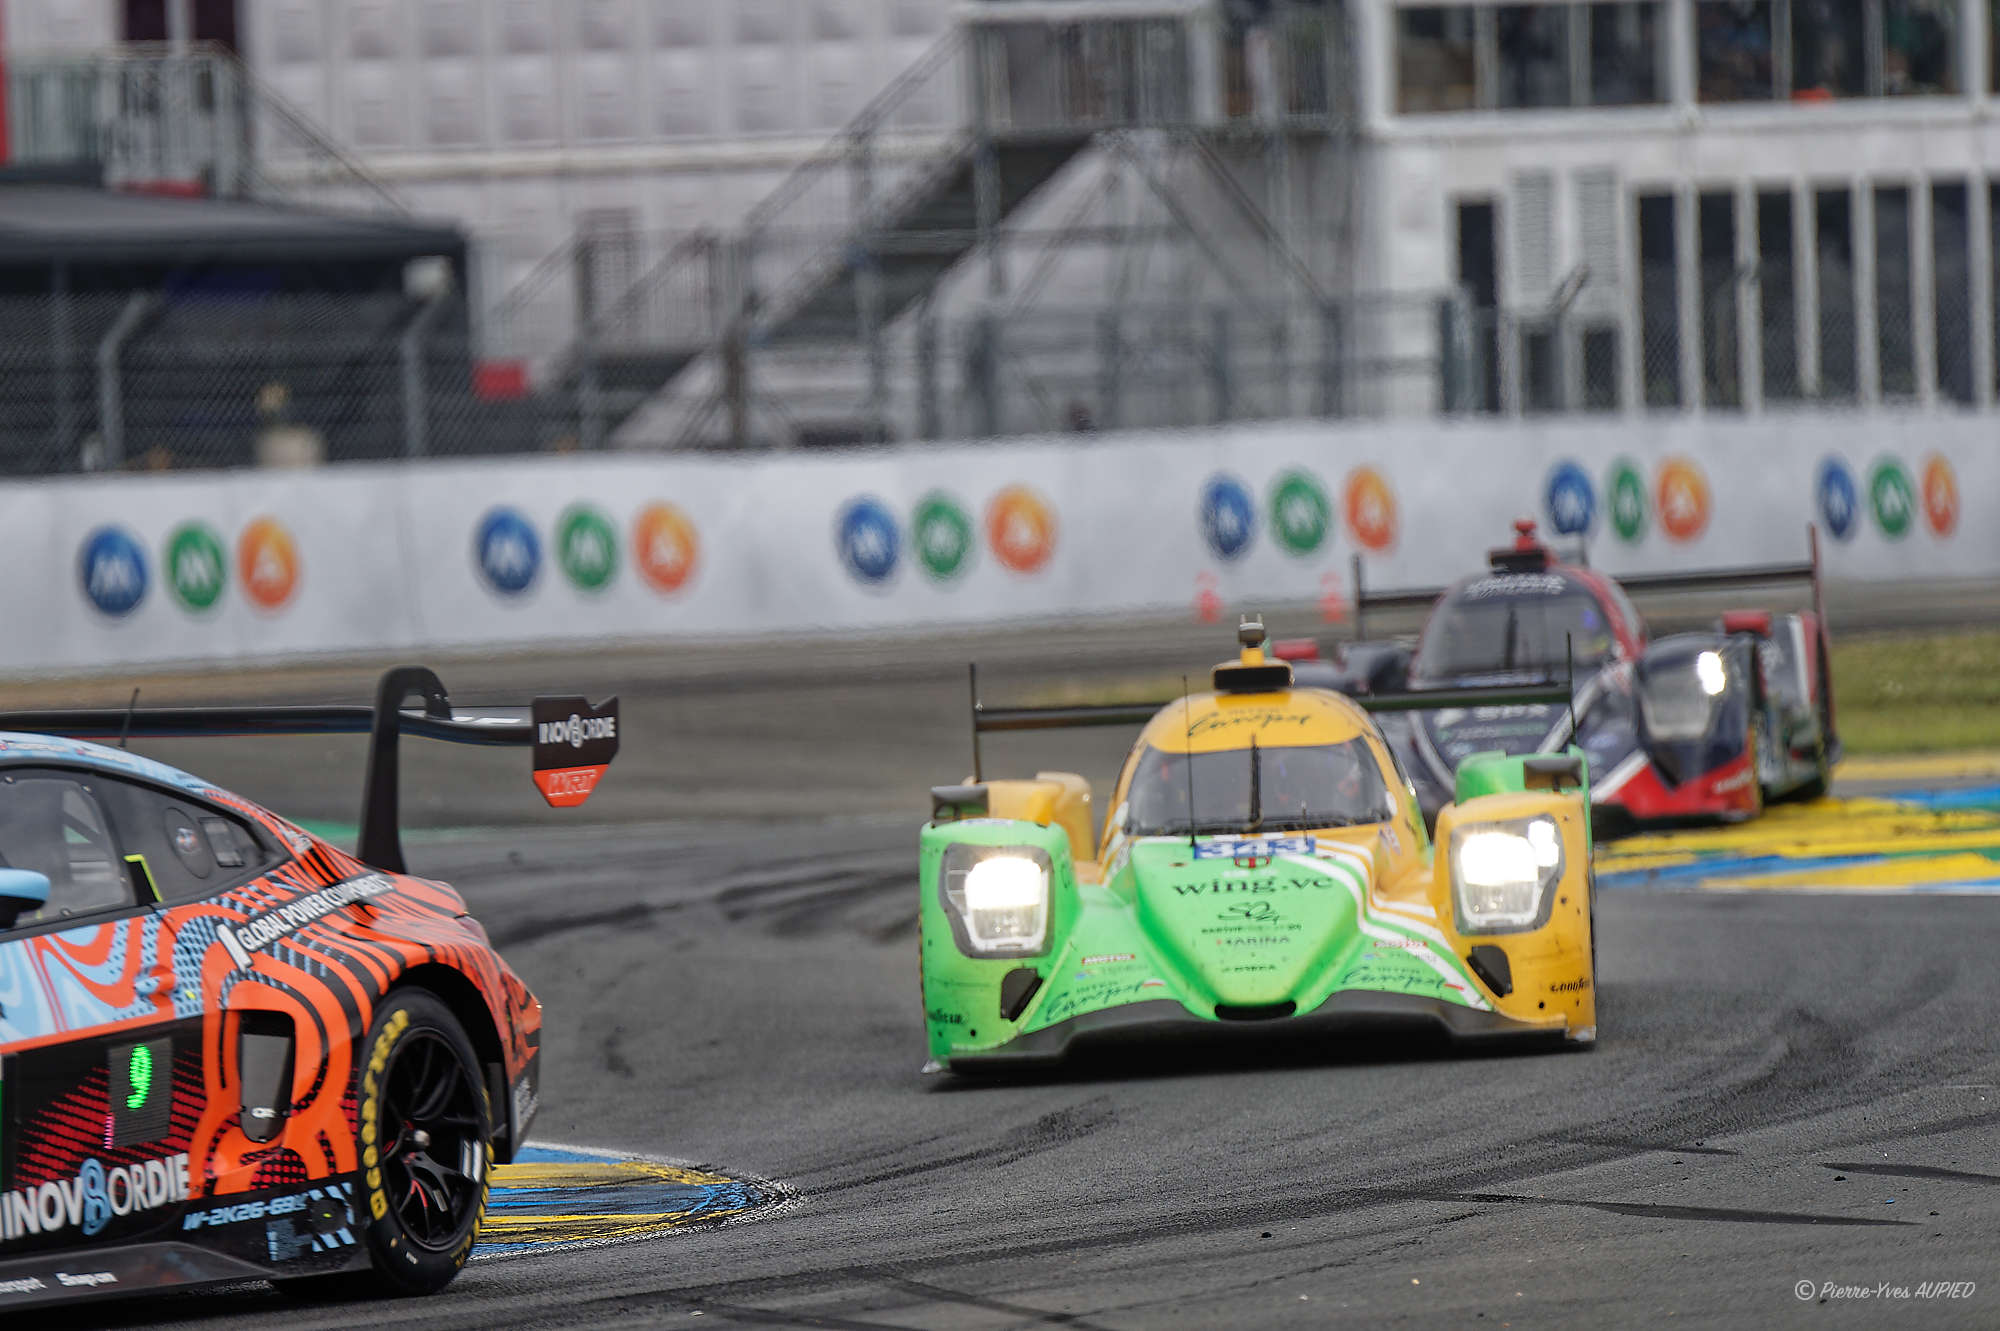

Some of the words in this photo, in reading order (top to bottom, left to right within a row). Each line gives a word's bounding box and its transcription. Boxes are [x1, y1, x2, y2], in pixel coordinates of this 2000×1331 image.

[1173, 877, 1334, 897] wing.vc
[236, 908, 293, 950] GLOBAL
[278, 891, 332, 931] POWER
